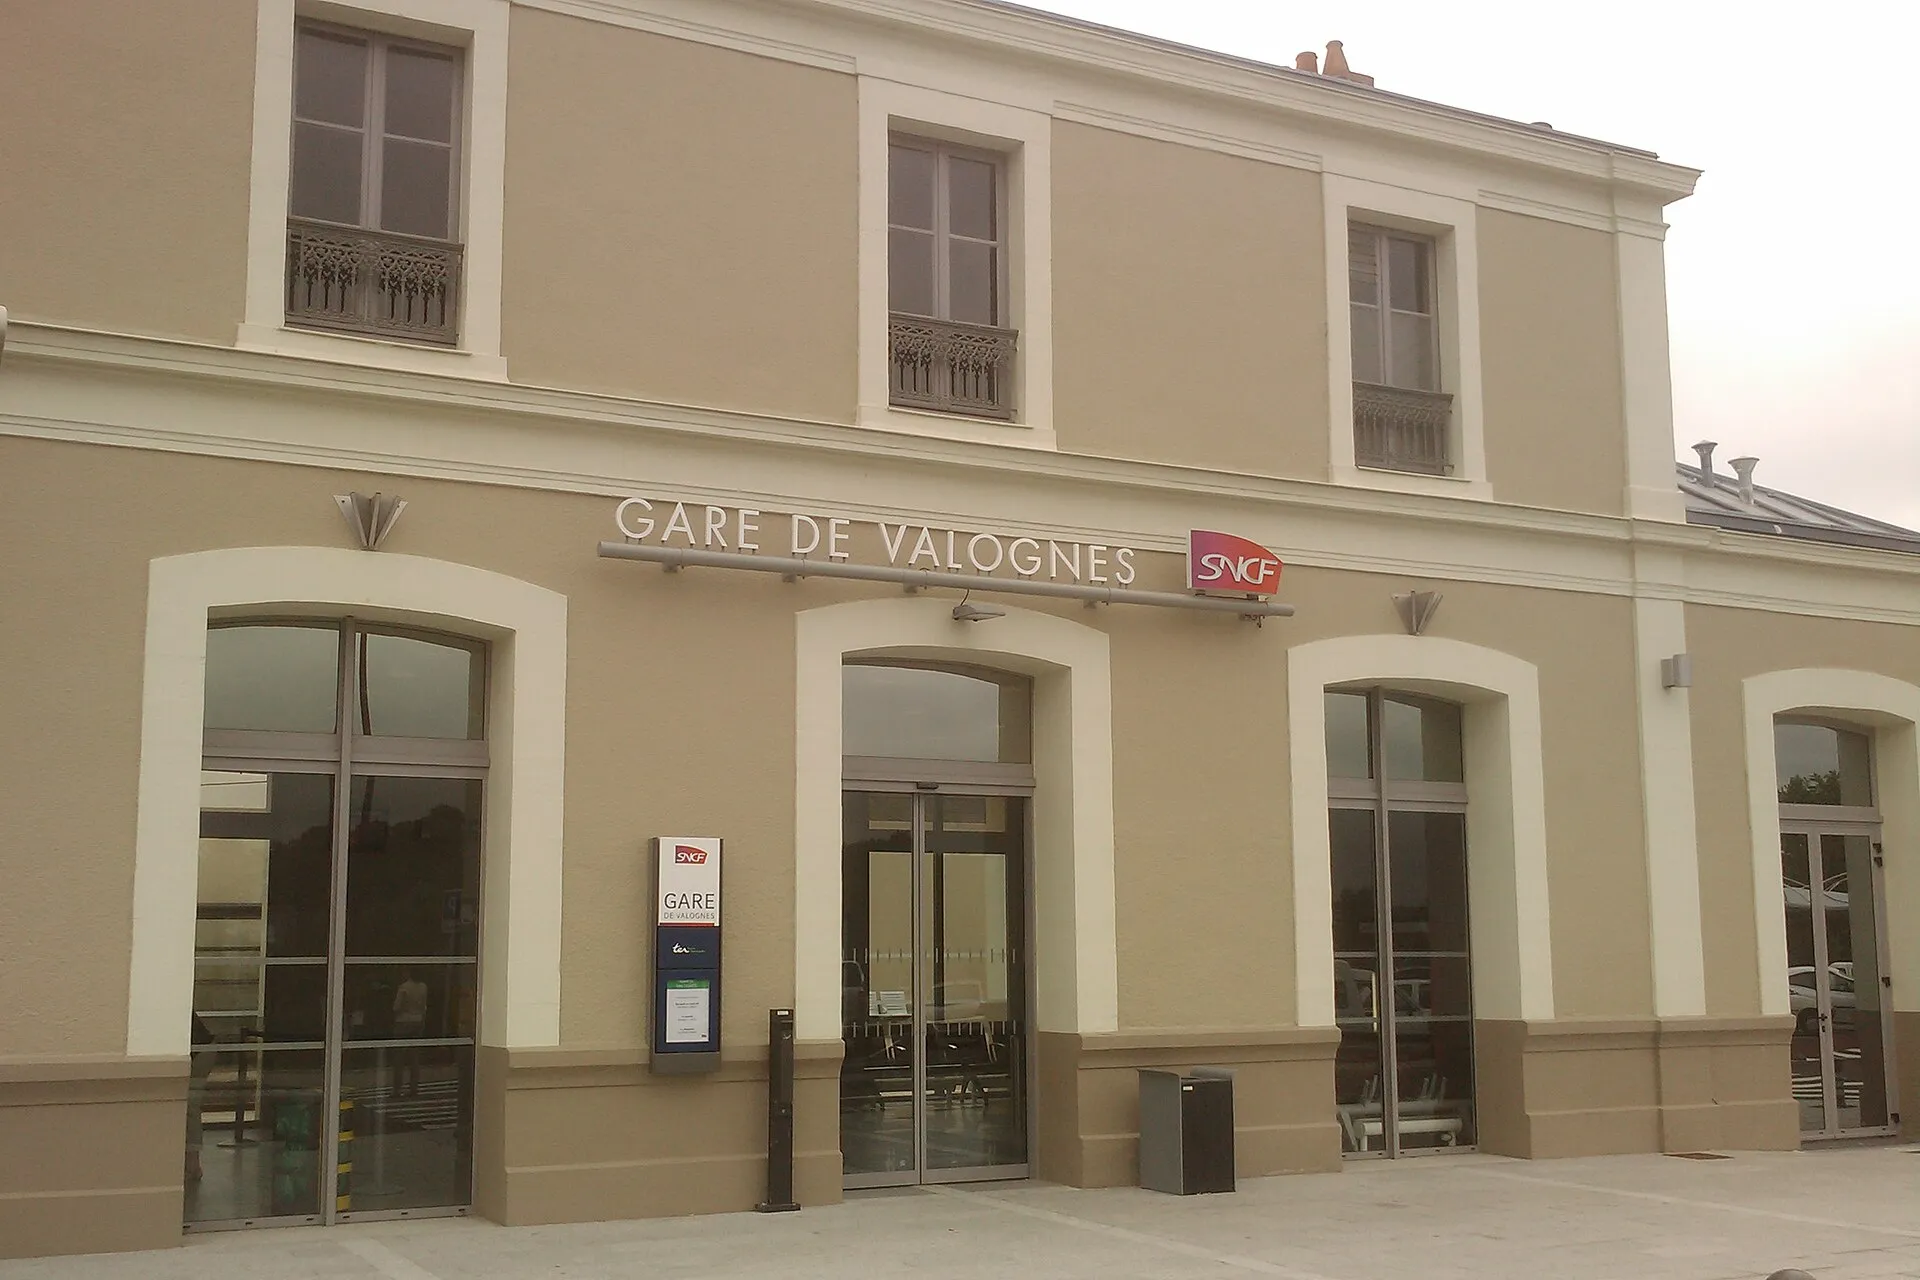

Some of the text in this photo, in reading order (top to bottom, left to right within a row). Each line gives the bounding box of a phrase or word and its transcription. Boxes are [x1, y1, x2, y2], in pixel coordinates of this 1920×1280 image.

[616, 498, 1136, 585] GARE DE VALOGNES
[1197, 553, 1279, 585] SNCF
[676, 852, 706, 862] SNCF
[664, 893, 715, 909] GARE
